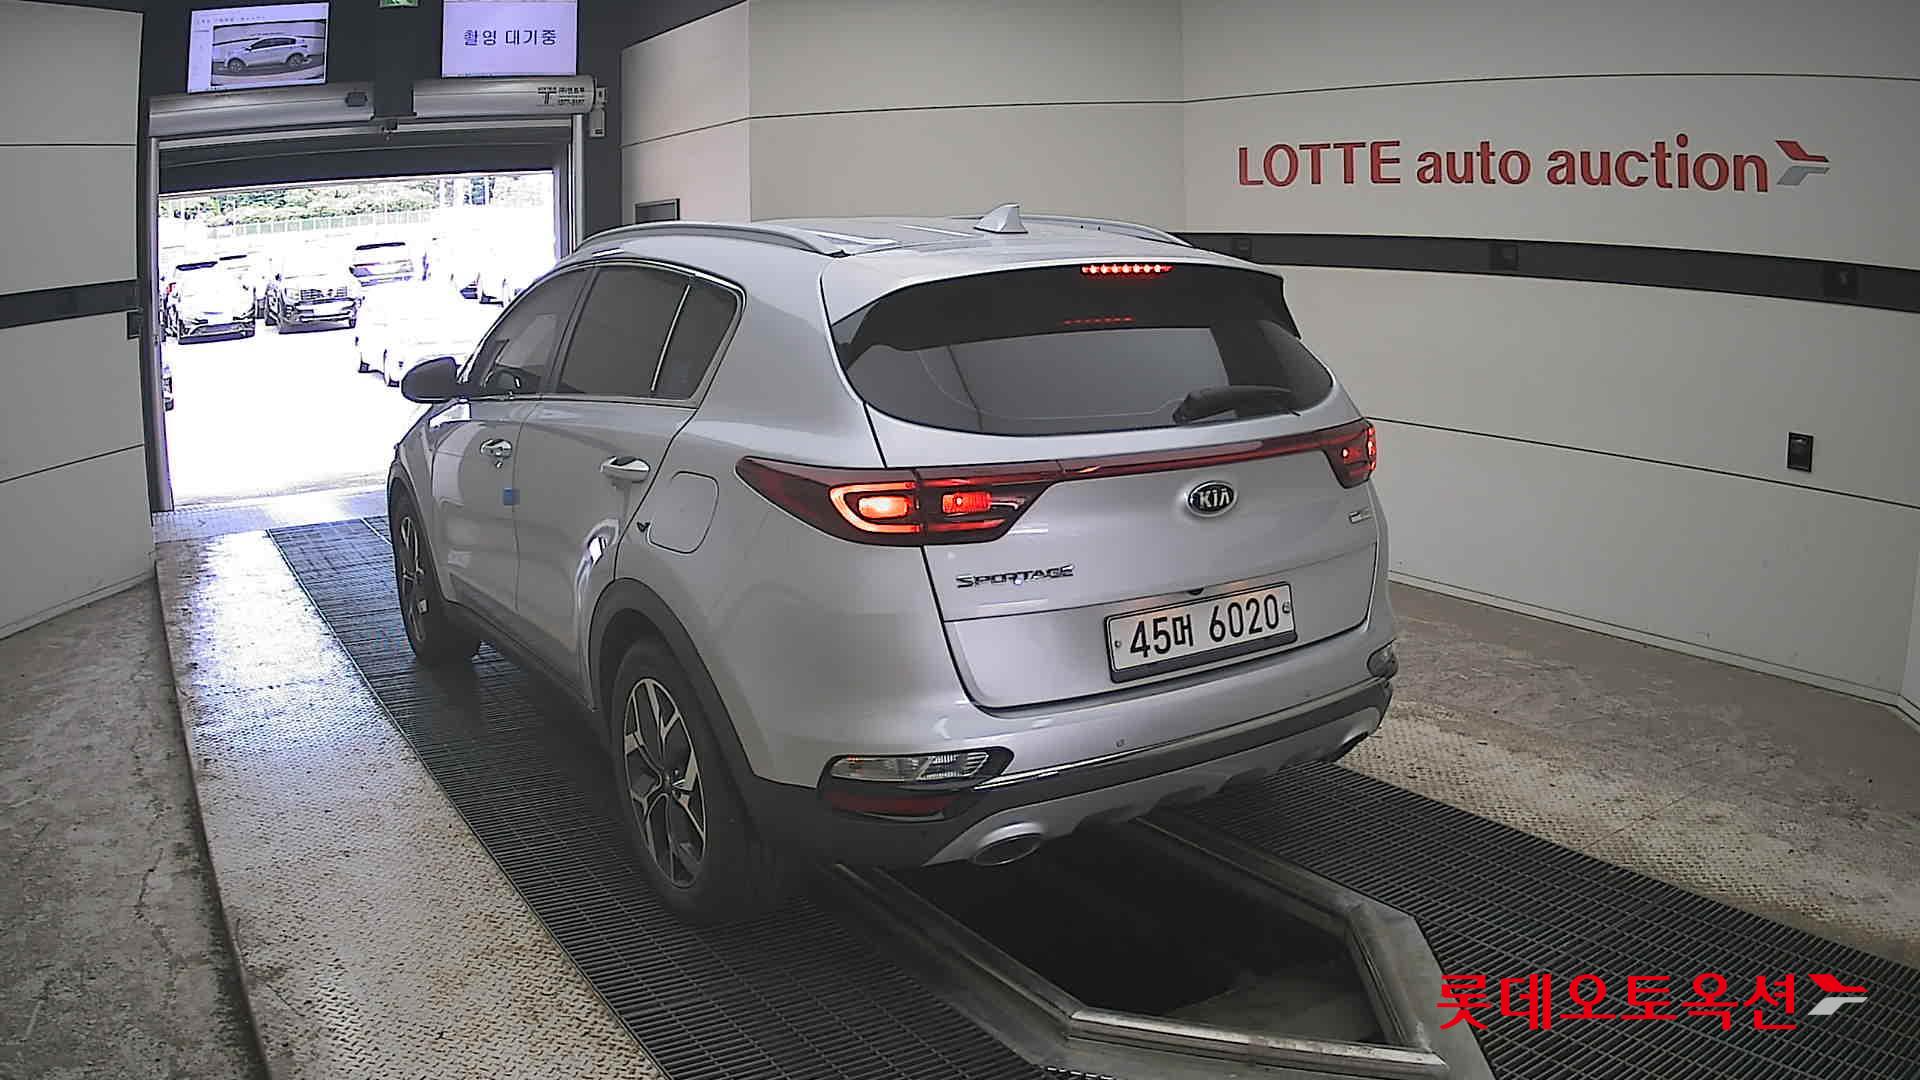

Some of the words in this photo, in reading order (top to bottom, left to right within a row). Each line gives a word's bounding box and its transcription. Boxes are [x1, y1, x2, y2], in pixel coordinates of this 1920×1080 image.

[505, 29, 557, 46] 대기중
[1238, 140, 1401, 187] LOTTE
[1416, 140, 1532, 186] auto
[1546, 132, 1770, 193] auction
[1199, 486, 1232, 509] KIA
[956, 564, 1075, 589] SPORTAGE
[1129, 612, 1195, 660] 45머
[1208, 593, 1281, 645] 6020
